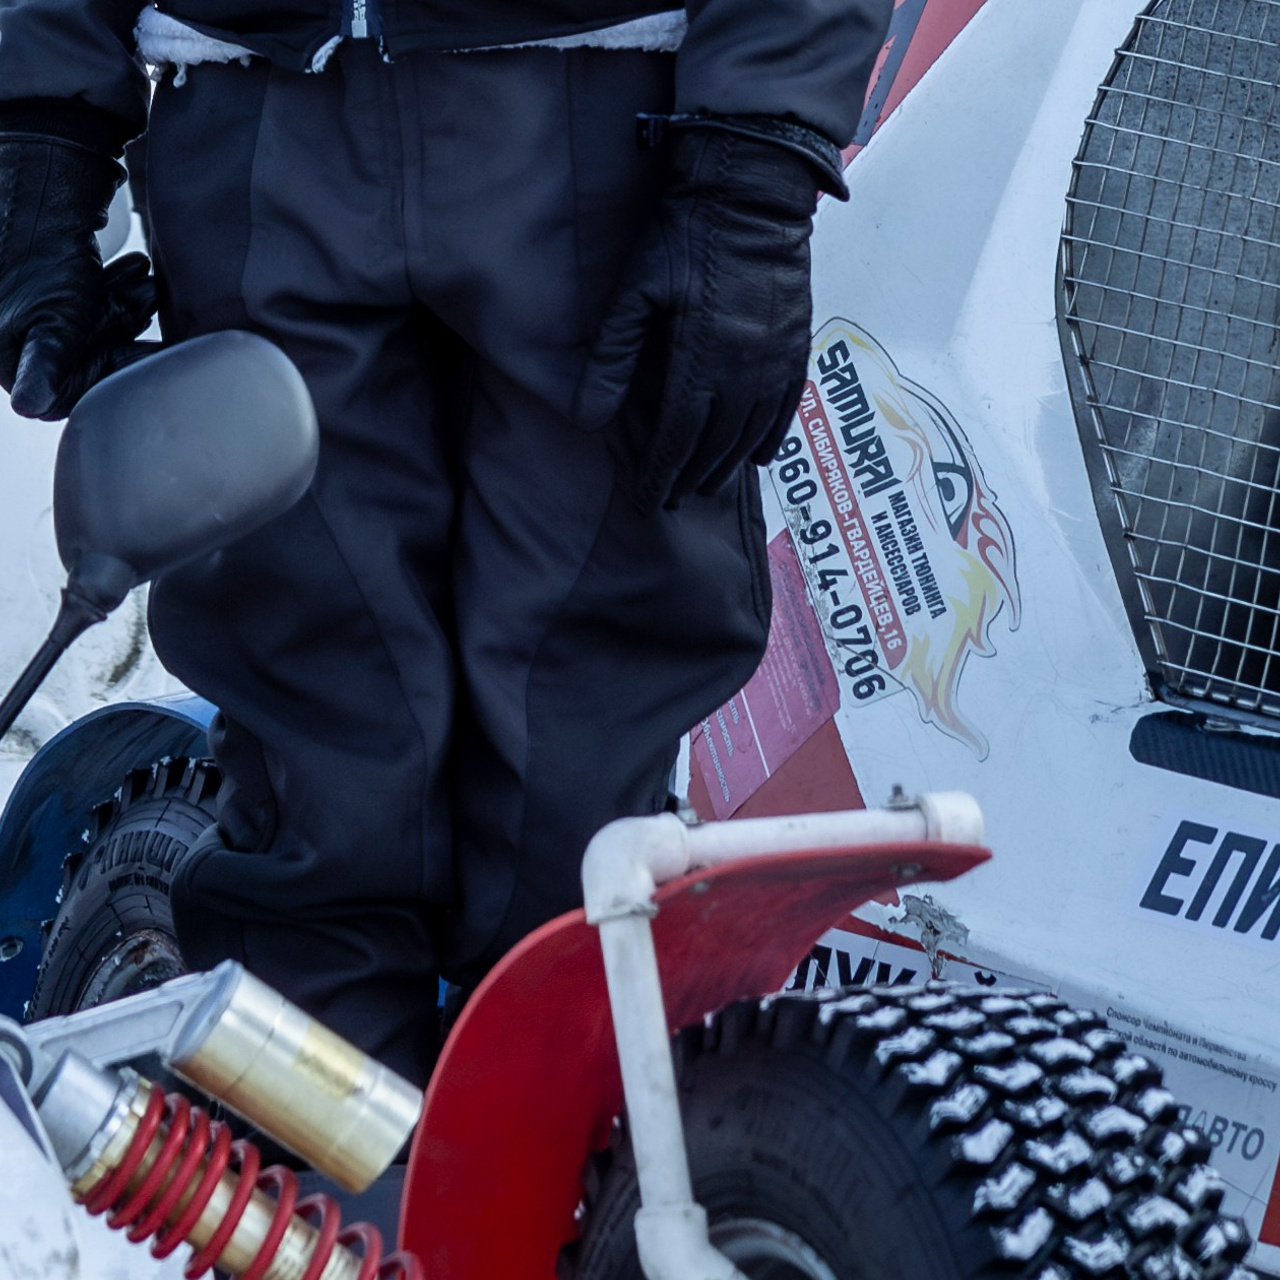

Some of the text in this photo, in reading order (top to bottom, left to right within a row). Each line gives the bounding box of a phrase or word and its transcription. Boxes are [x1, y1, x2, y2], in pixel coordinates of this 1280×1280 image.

[800, 387, 817, 417] УЛ.
[816, 339, 903, 499] SAMURAI
[870, 510, 922, 616] И АКСЕССУАРОВ
[888, 490, 947, 619] МАГАЗИН ТЮНИНГА
[1106, 1006, 1142, 1028] Спонсор
[1167, 1046, 1178, 1059] по
